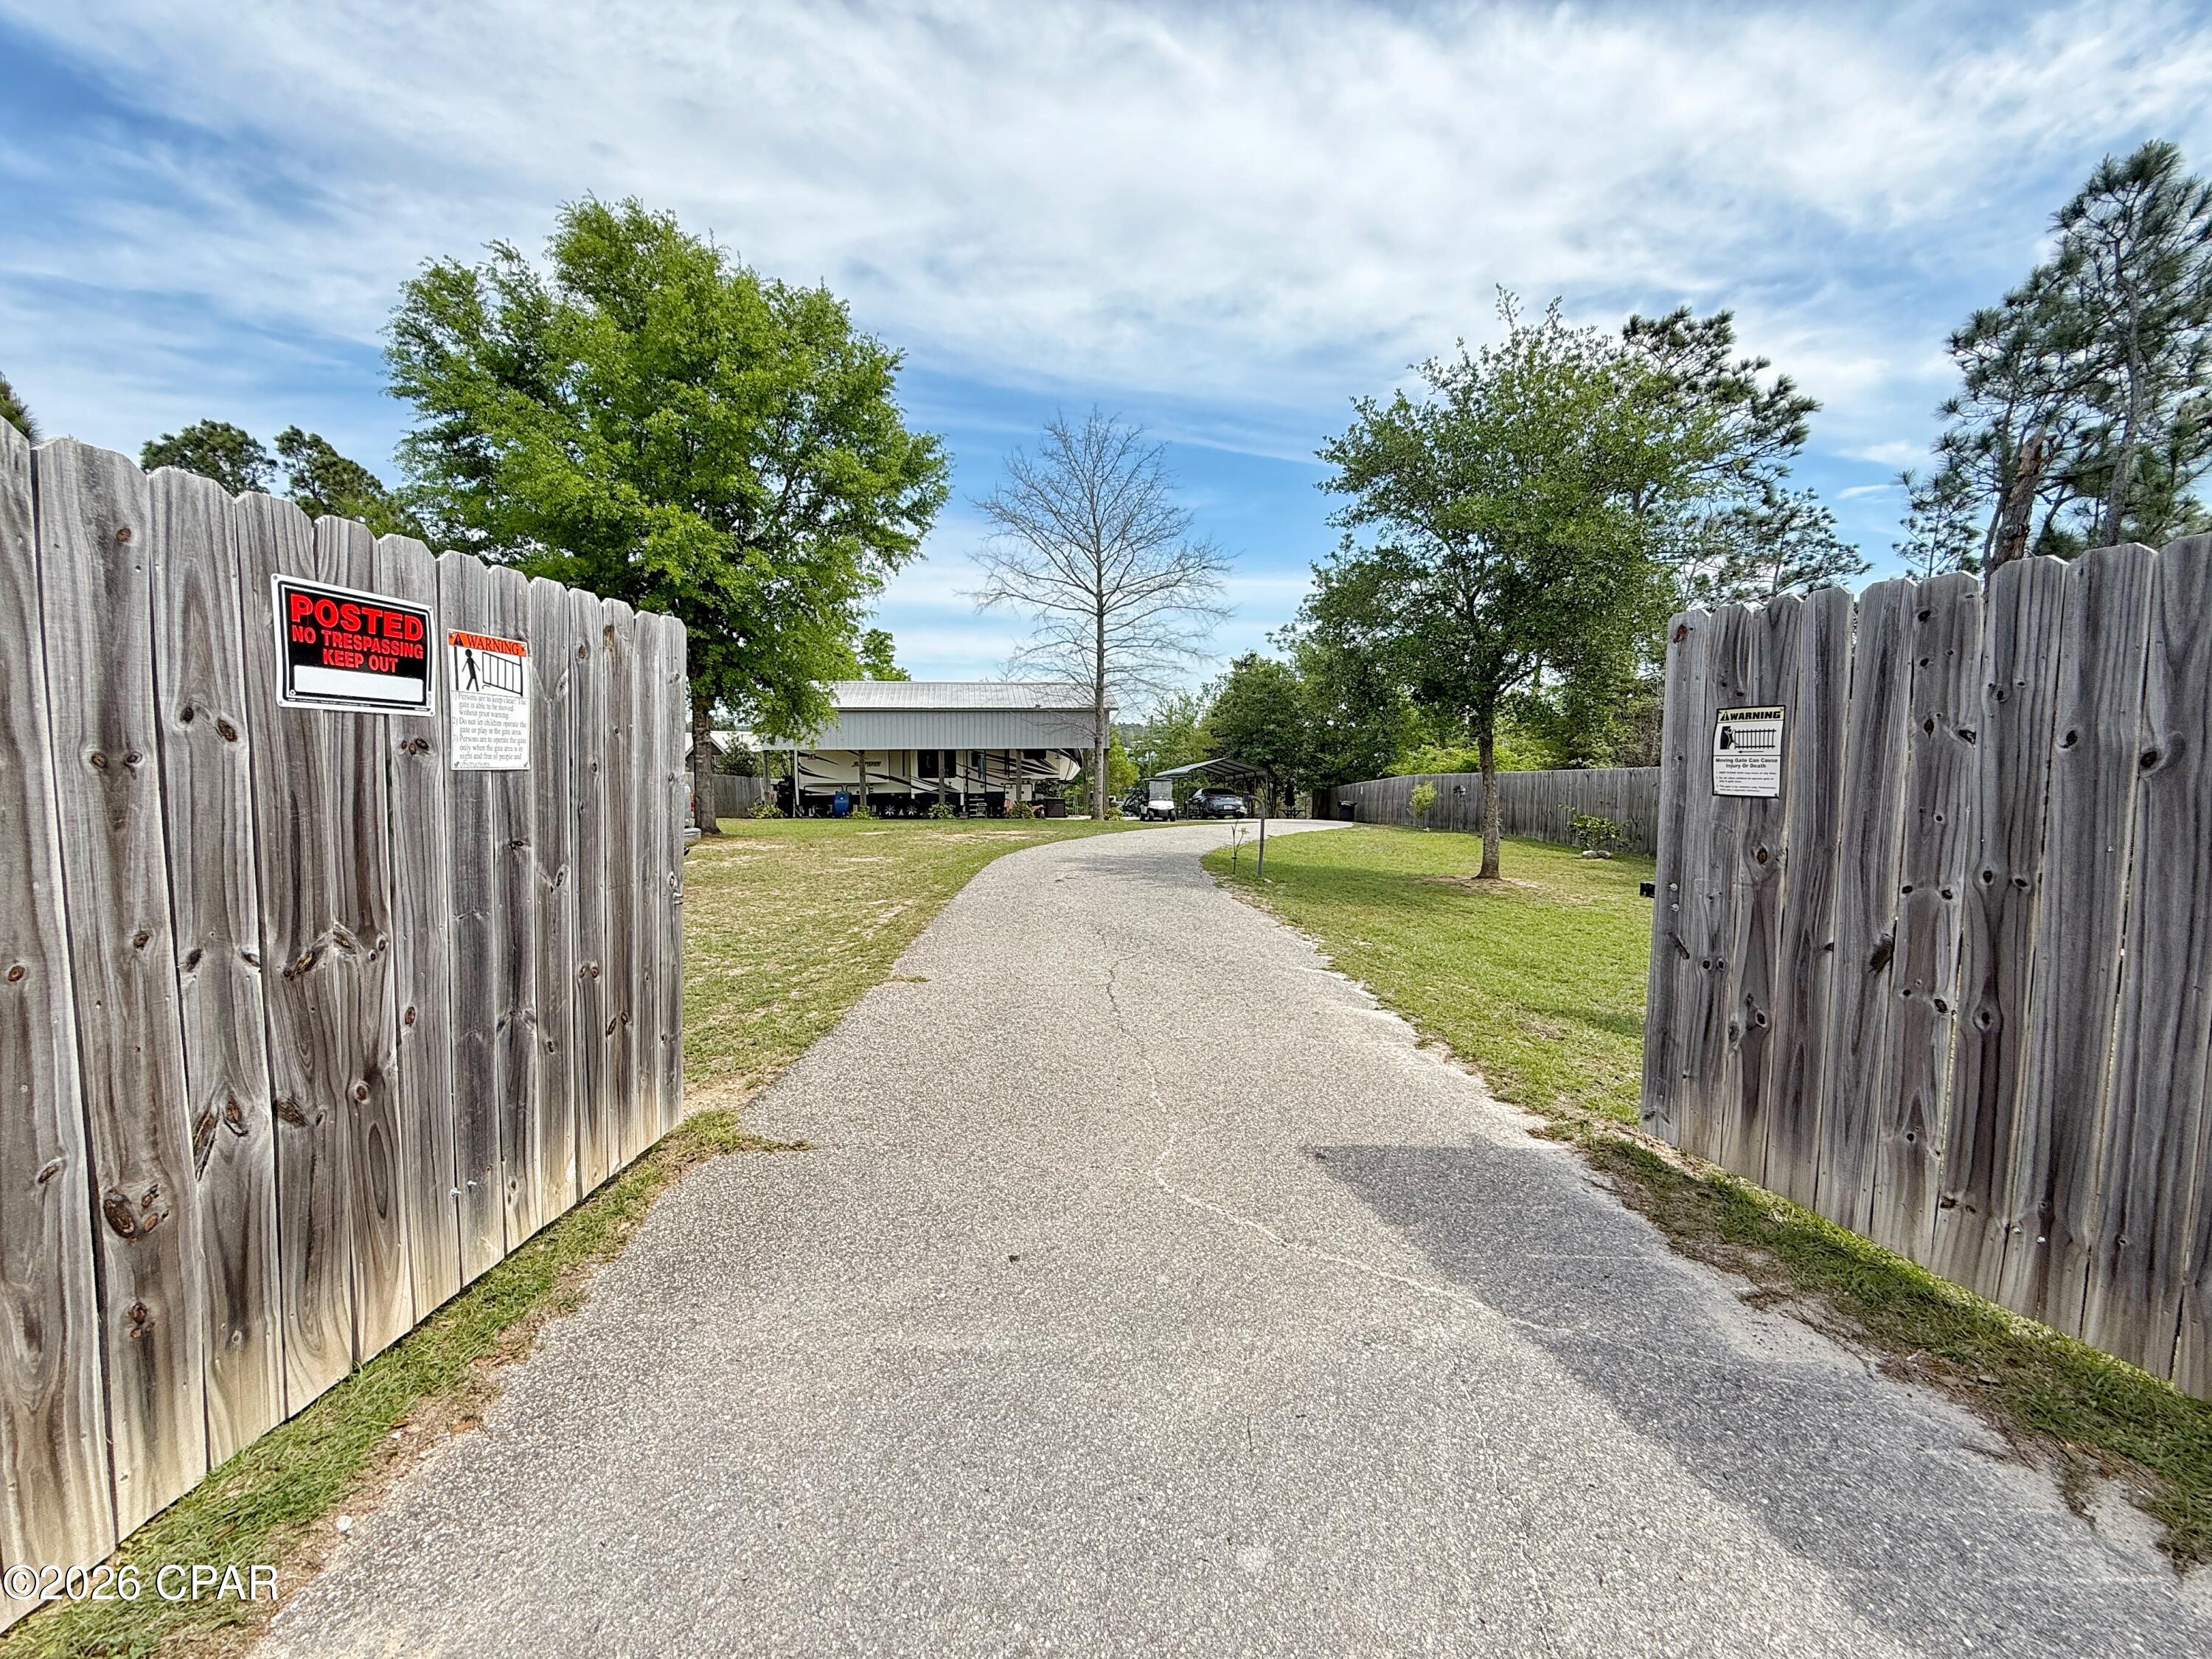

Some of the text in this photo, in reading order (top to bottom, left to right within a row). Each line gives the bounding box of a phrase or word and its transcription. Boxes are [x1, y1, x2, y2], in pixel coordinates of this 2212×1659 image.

[291, 594, 423, 641] POSTED
[292, 625, 424, 659] NO TRESPASSING
[467, 634, 519, 655] WARNING
[322, 649, 398, 672] KEEP OUT
[459, 692, 477, 701] Persons
[492, 695, 502, 704] keep
[459, 717, 467, 725] Do
[484, 718, 501, 726] children
[1731, 711, 1781, 720] WARNING
[478, 726, 487, 735] play
[459, 733, 479, 742] Persons
[517, 738, 526, 746] gate
[459, 751, 472, 761] sight
[498, 753, 513, 761] people
